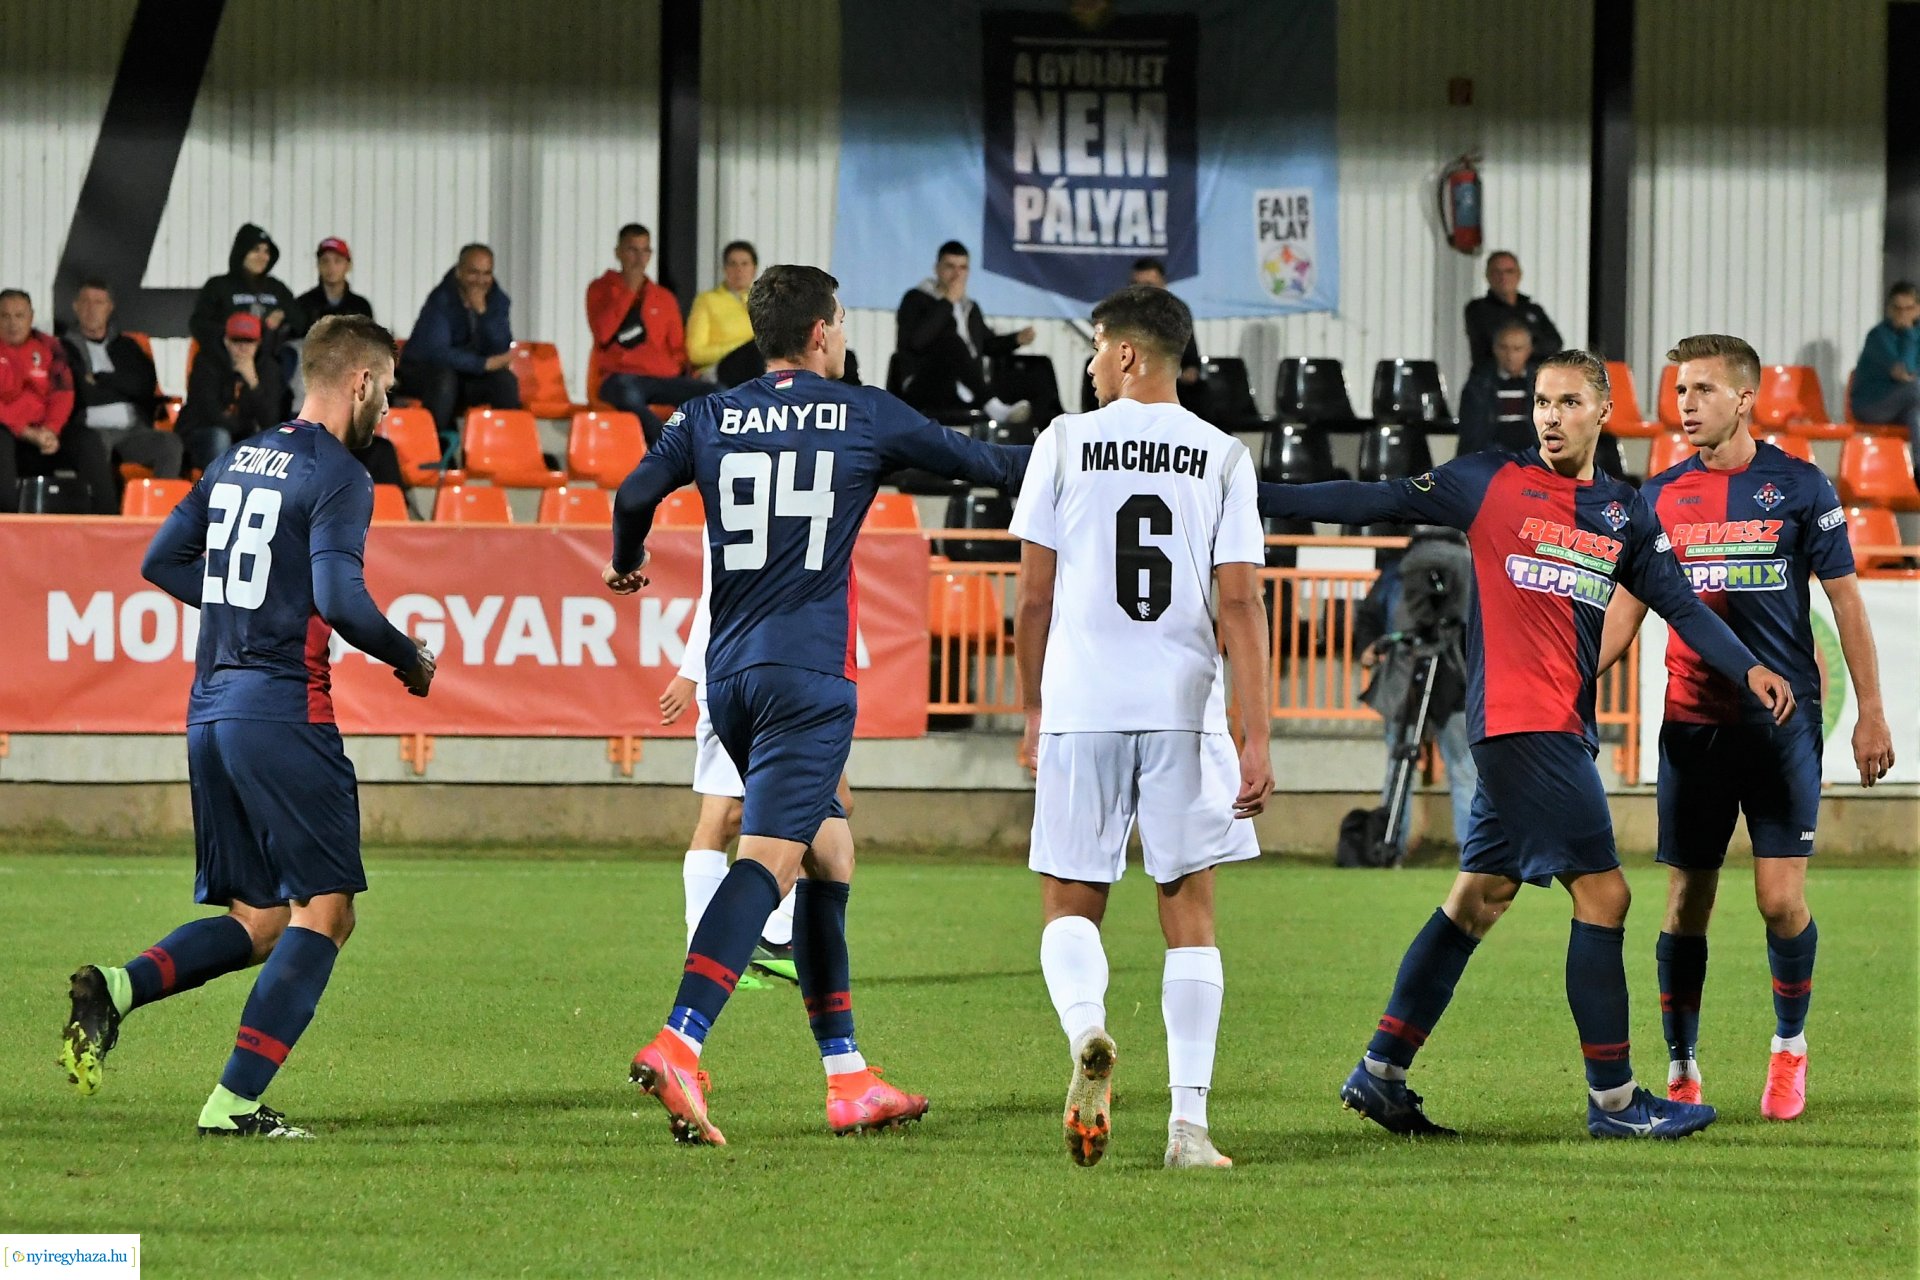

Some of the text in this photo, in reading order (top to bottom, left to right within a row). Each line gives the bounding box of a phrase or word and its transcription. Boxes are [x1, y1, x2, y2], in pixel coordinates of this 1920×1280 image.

[1013, 88, 1168, 177] NEM
[1013, 177, 1168, 247] PÁLYA!
[1259, 196, 1308, 217] FAIR
[1260, 219, 1308, 241] PLAY
[720, 403, 847, 435] BANYOI
[228, 446, 294, 480] SZOKOL
[1081, 440, 1208, 479] MACHACH
[718, 450, 835, 571] 94
[201, 483, 282, 610] 28
[1518, 517, 1623, 564] REVESZ
[1671, 520, 1784, 547] REVESZ
[1687, 546, 1713, 554] ALWAYS
[1116, 494, 1172, 621] 6
